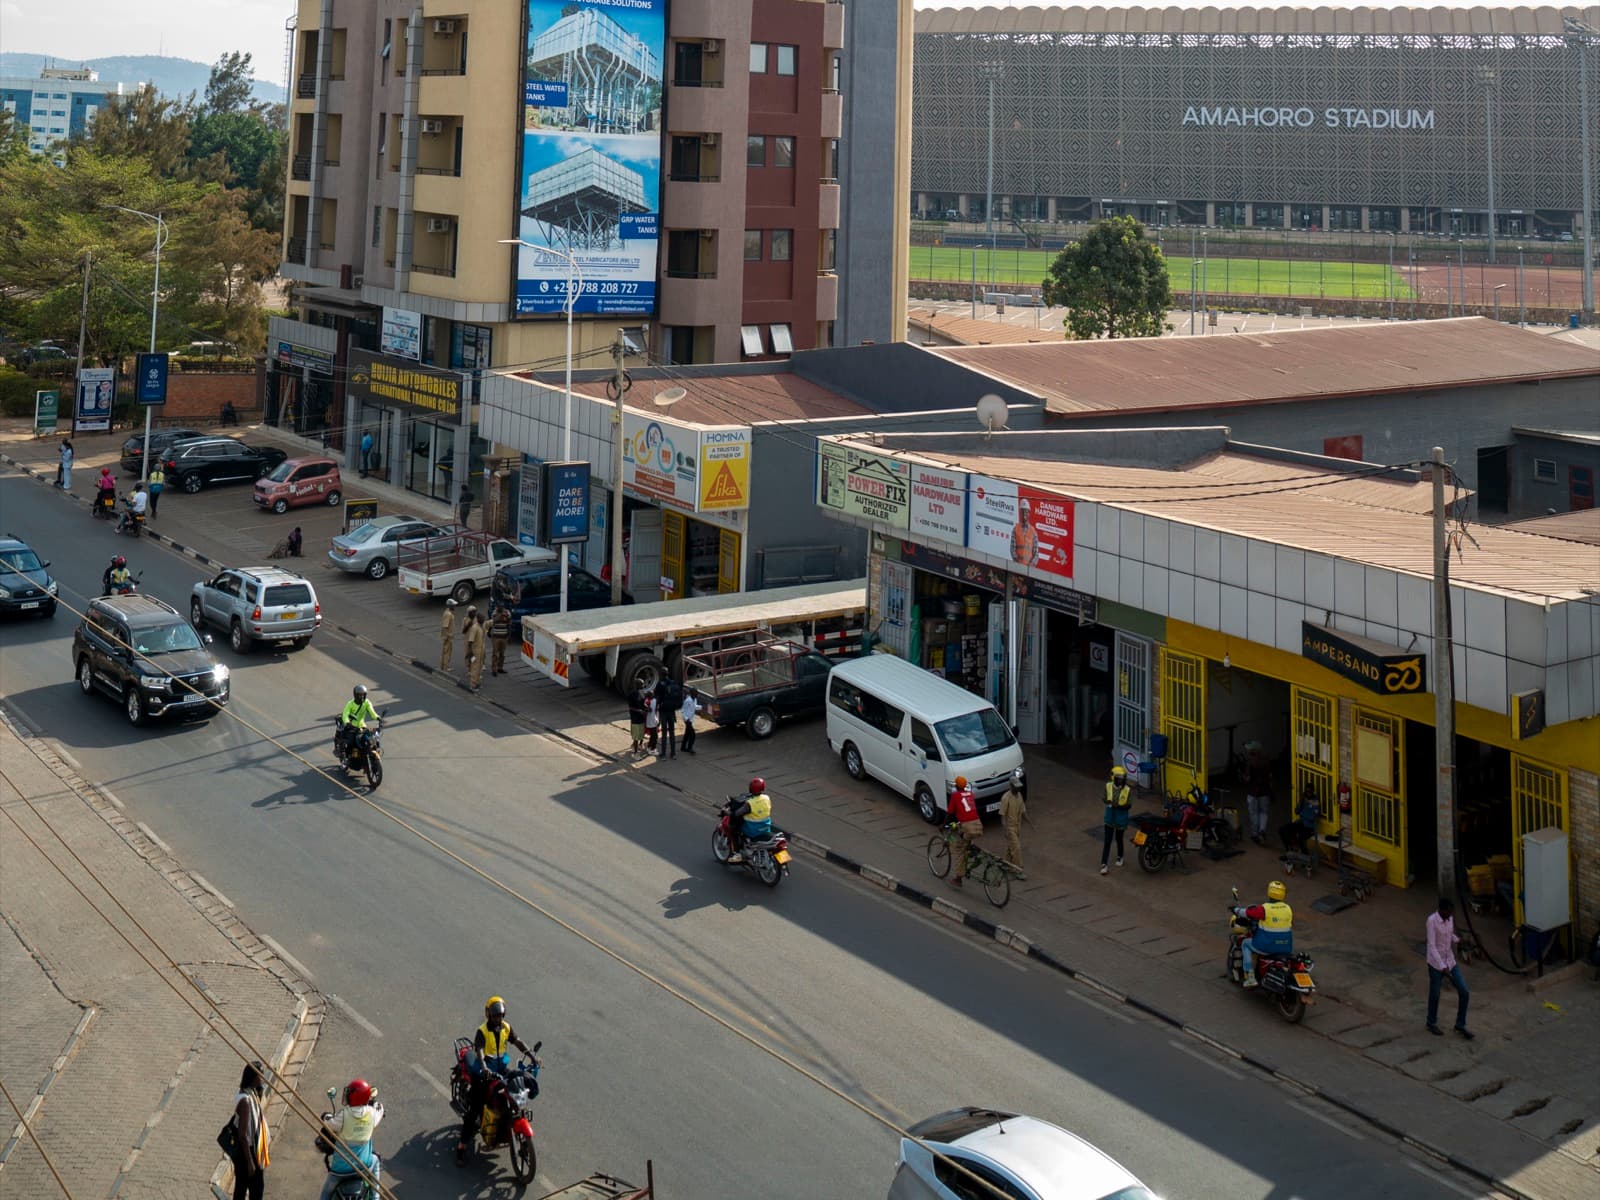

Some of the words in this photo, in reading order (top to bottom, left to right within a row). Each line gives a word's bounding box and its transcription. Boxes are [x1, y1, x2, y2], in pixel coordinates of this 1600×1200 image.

[526, 82, 543, 91] STEEL
[544, 84, 566, 93] WATER
[526, 93, 546, 101] TANKS
[1182, 106, 1315, 127] AMAHORO
[1325, 108, 1434, 129] STADIUM
[621, 215, 633, 223] GRP
[634, 216, 656, 224] WATER
[638, 226, 657, 234] TANKS
[581, 282, 598, 293] 788
[601, 283, 618, 293] 208
[621, 283, 638, 293] 727
[412, 391, 437, 410] TRADING
[706, 432, 745, 443] HOMNA
[709, 473, 737, 498] Sika
[920, 472, 955, 488] DANUBE
[559, 487, 583, 498] DARE
[847, 474, 907, 504] POWERFIX
[913, 484, 961, 506] HARDWARE
[558, 498, 570, 507] TO
[571, 497, 583, 506] BE
[854, 495, 898, 514] AUTHORIZED
[928, 502, 945, 516] LTD
[1040, 501, 1065, 514] DANUBE
[555, 506, 585, 517] MORE!
[862, 506, 889, 520] DEALER
[1034, 507, 1068, 522] HARDWARE
[1303, 636, 1380, 681] AMPERSAND
